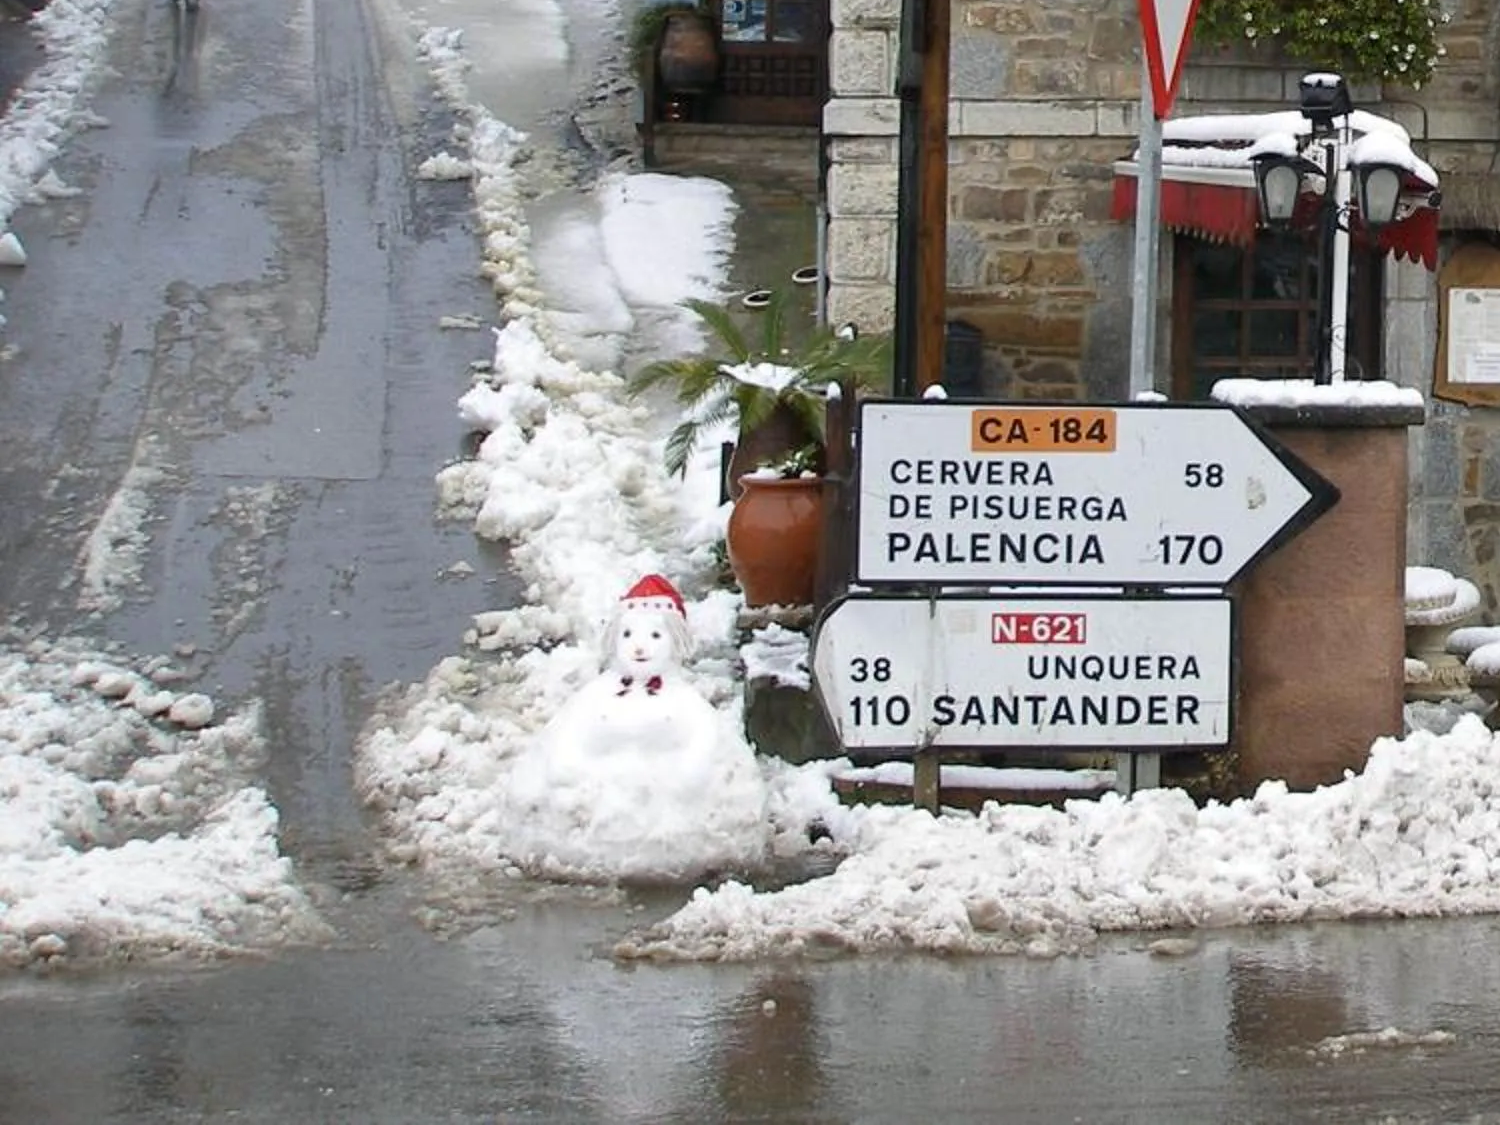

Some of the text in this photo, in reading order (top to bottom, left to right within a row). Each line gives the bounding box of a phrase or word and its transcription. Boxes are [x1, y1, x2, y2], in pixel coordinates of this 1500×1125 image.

[890, 459, 1055, 487] CERVERA
[1183, 463, 1225, 488] 58
[888, 493, 1129, 523] DE PISUERGA
[887, 531, 1106, 565] PALENCIA
[1158, 533, 1224, 566] 170
[993, 615, 1086, 642] N-621
[849, 656, 893, 683] 38
[1027, 654, 1201, 682] UNQUERA
[849, 696, 912, 727] 110
[931, 694, 1200, 727] SANTANDER
